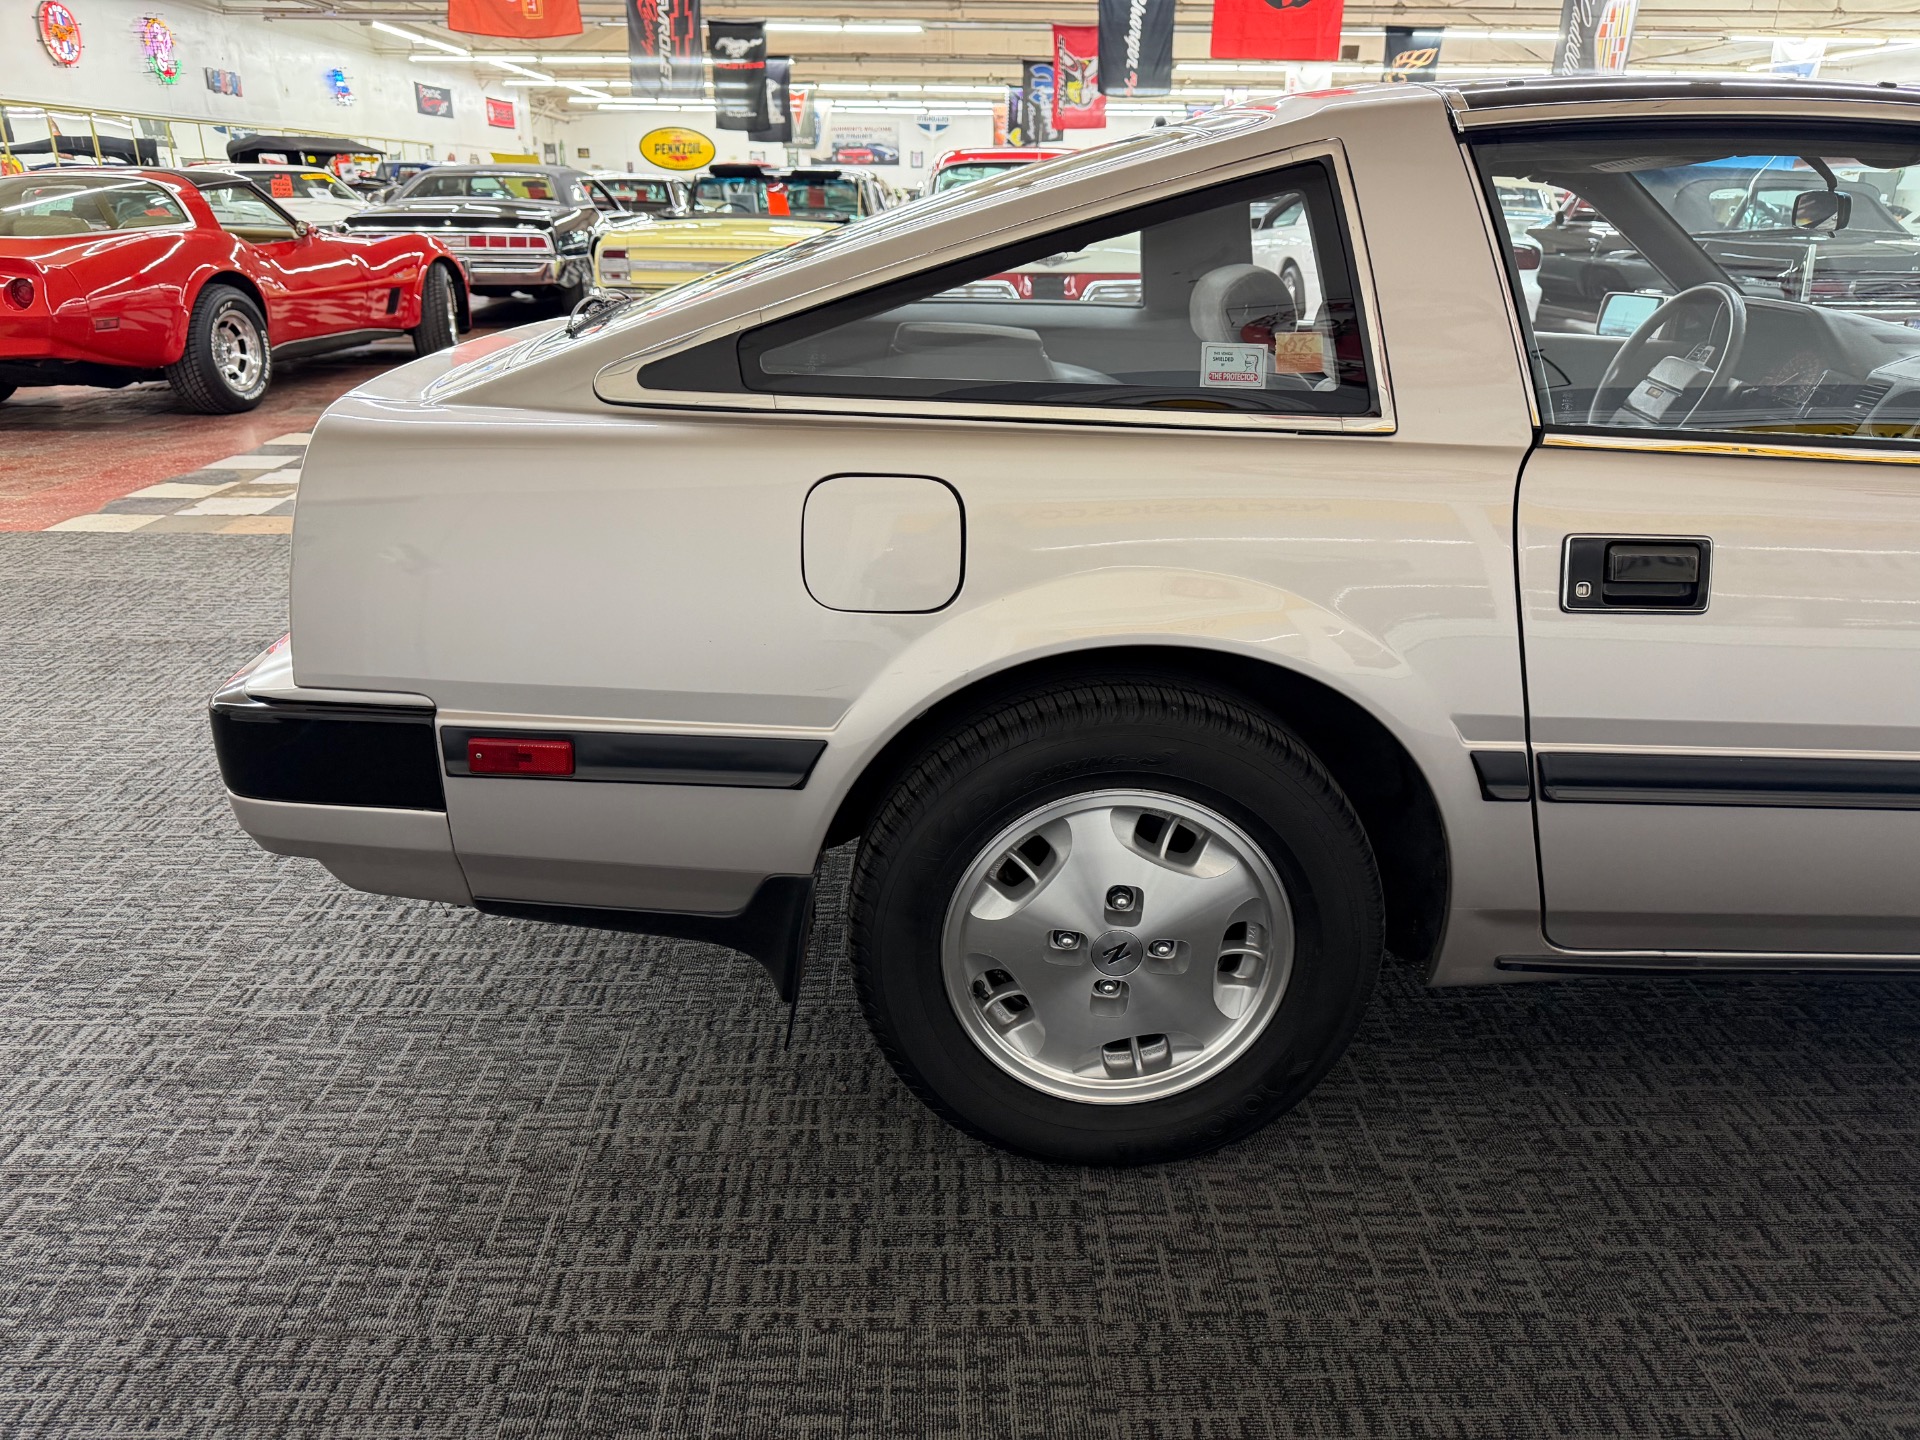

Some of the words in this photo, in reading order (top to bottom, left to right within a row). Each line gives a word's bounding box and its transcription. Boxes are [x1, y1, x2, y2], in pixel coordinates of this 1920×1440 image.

[656, 0, 673, 91] EVROLET
[654, 142, 703, 155] PENNZOIL
[1223, 373, 1255, 382] PROTECTOR
